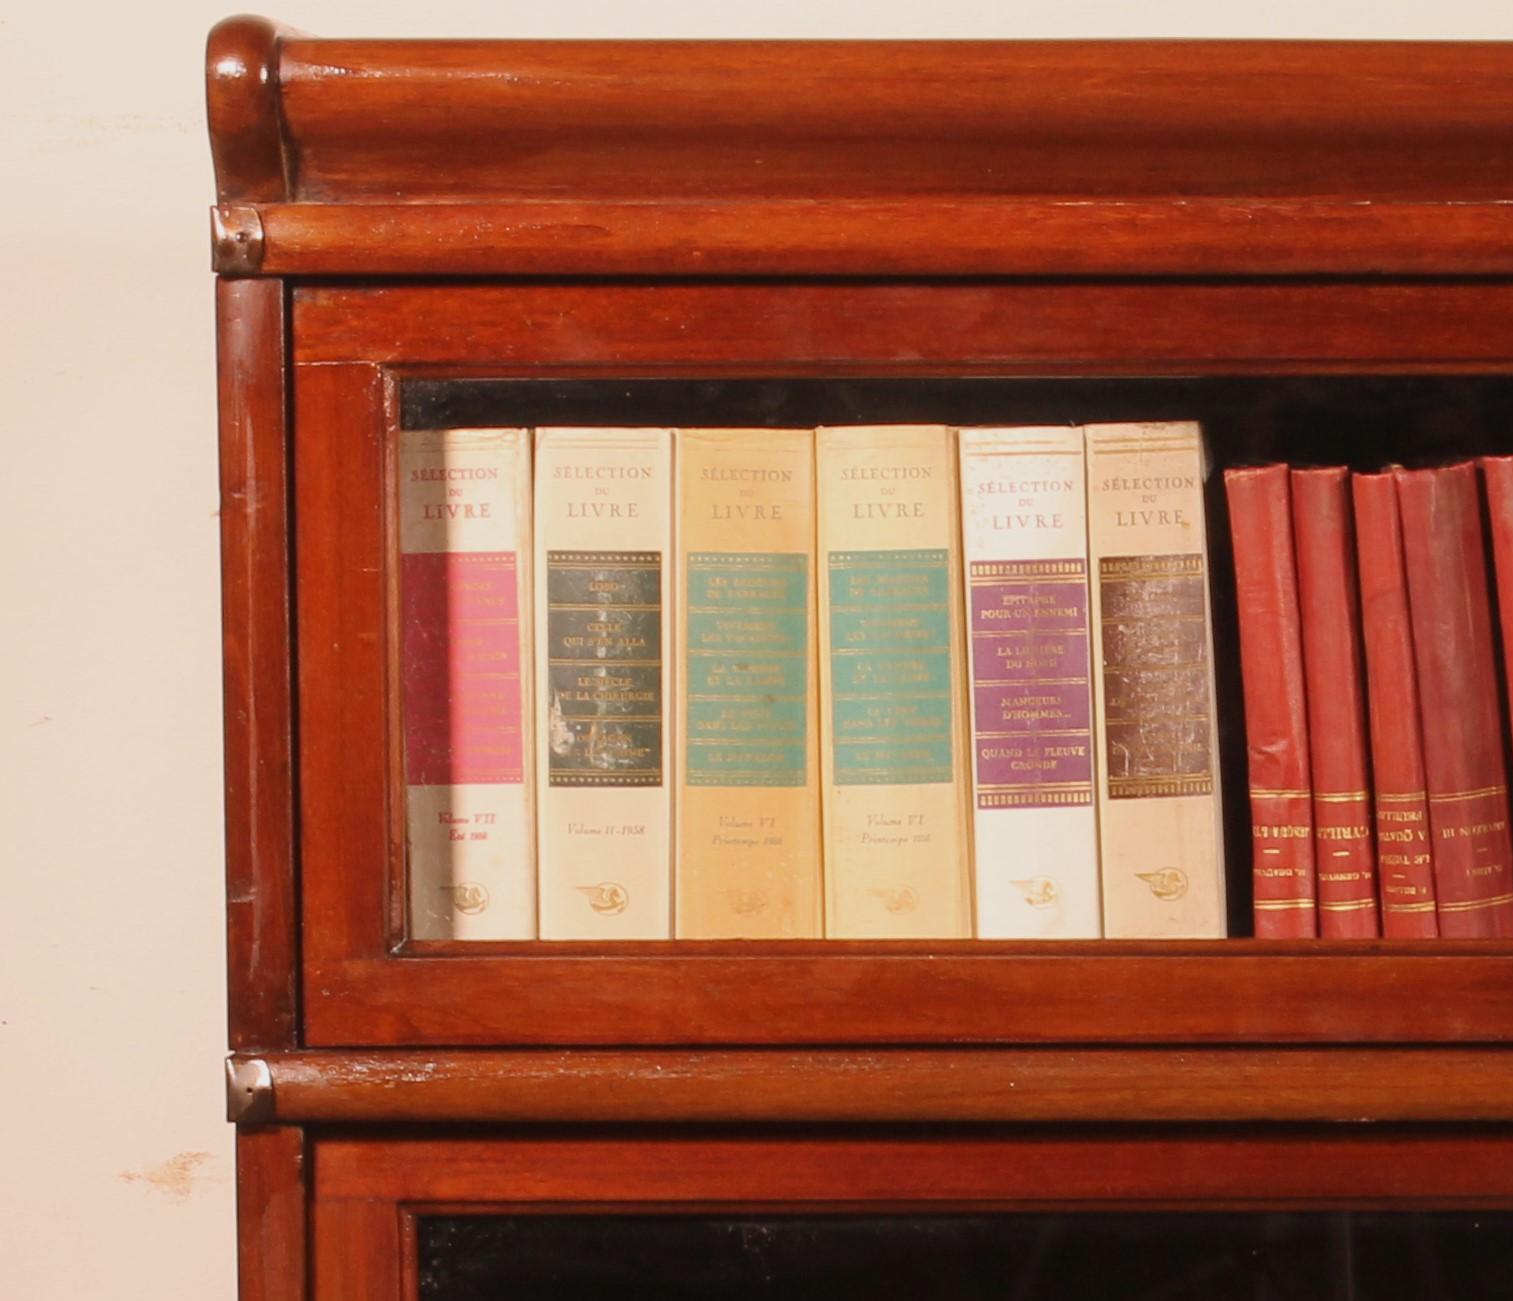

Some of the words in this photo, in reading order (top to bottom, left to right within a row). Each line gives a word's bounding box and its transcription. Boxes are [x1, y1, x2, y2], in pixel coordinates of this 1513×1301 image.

[424, 503, 491, 519] LIVRE
[568, 503, 639, 518] LIVRE
[711, 505, 783, 520] LIVRE
[853, 503, 924, 519] LIVRE
[1116, 509, 1184, 526] LIVRE
[992, 513, 1064, 530] LIVRE
[981, 608, 1011, 619] POUR
[563, 637, 584, 648] QUI
[618, 637, 646, 647] ALLA
[576, 691, 590, 701] LA
[1044, 746, 1086, 757] FLEUVE
